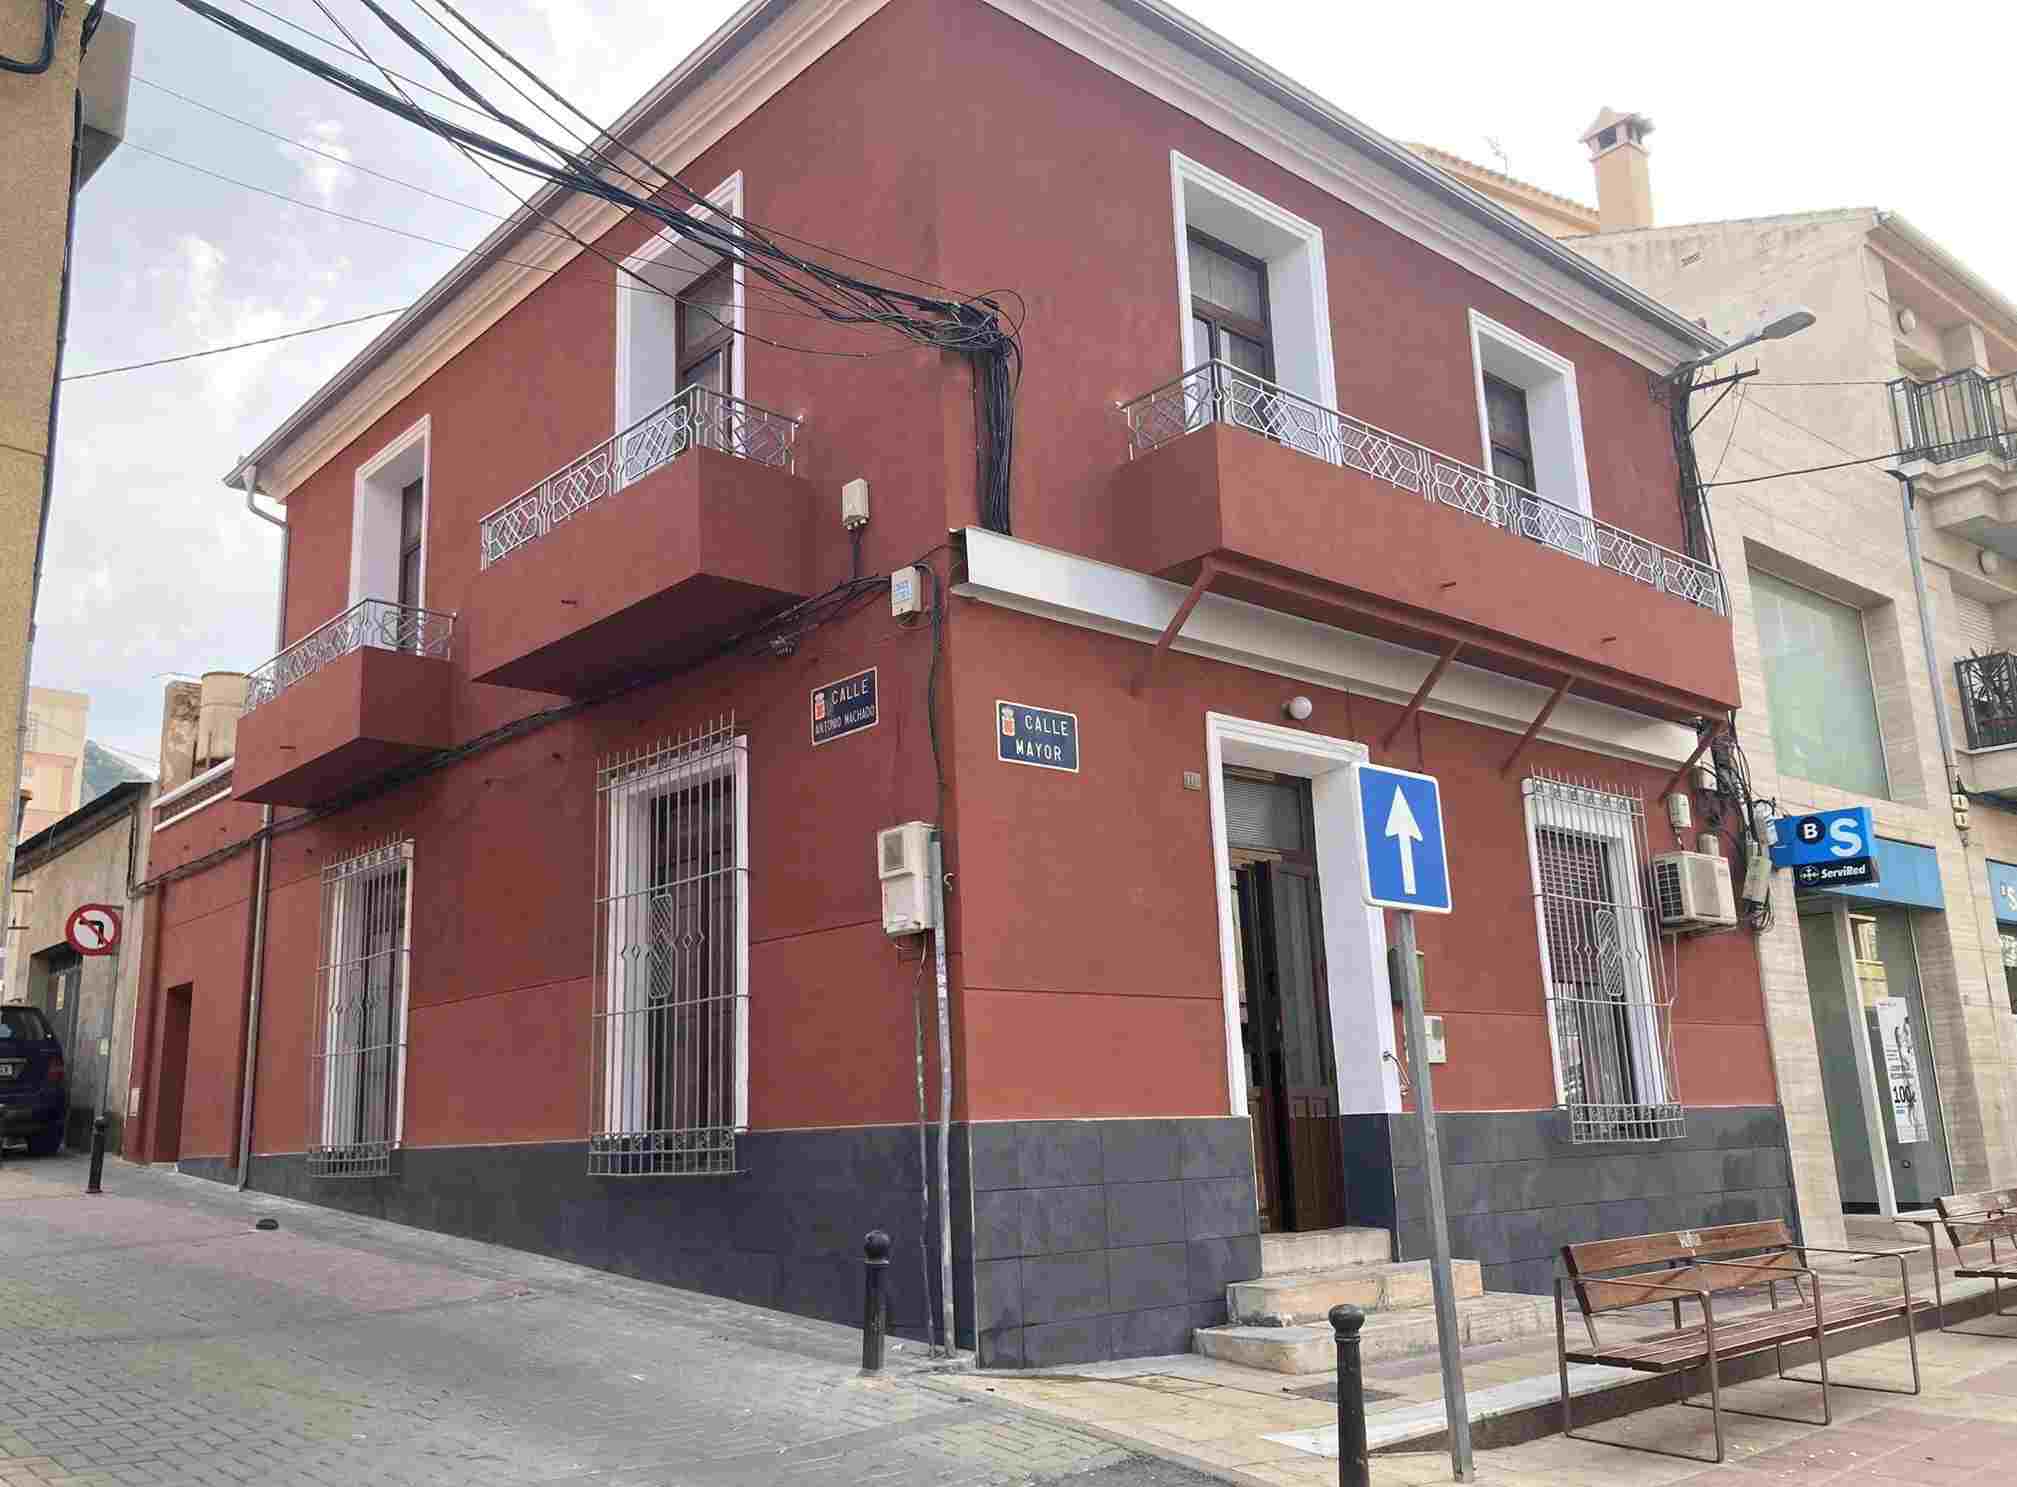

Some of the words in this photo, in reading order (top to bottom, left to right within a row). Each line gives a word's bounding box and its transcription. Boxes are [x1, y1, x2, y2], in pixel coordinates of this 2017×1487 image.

[832, 679, 870, 704] CALLE
[1024, 715, 1069, 736] CALLE
[1015, 739, 1062, 761] MAYOR
[1803, 823, 1818, 839] B
[1829, 817, 1862, 857] S
[1821, 863, 1866, 879] ServiRed
